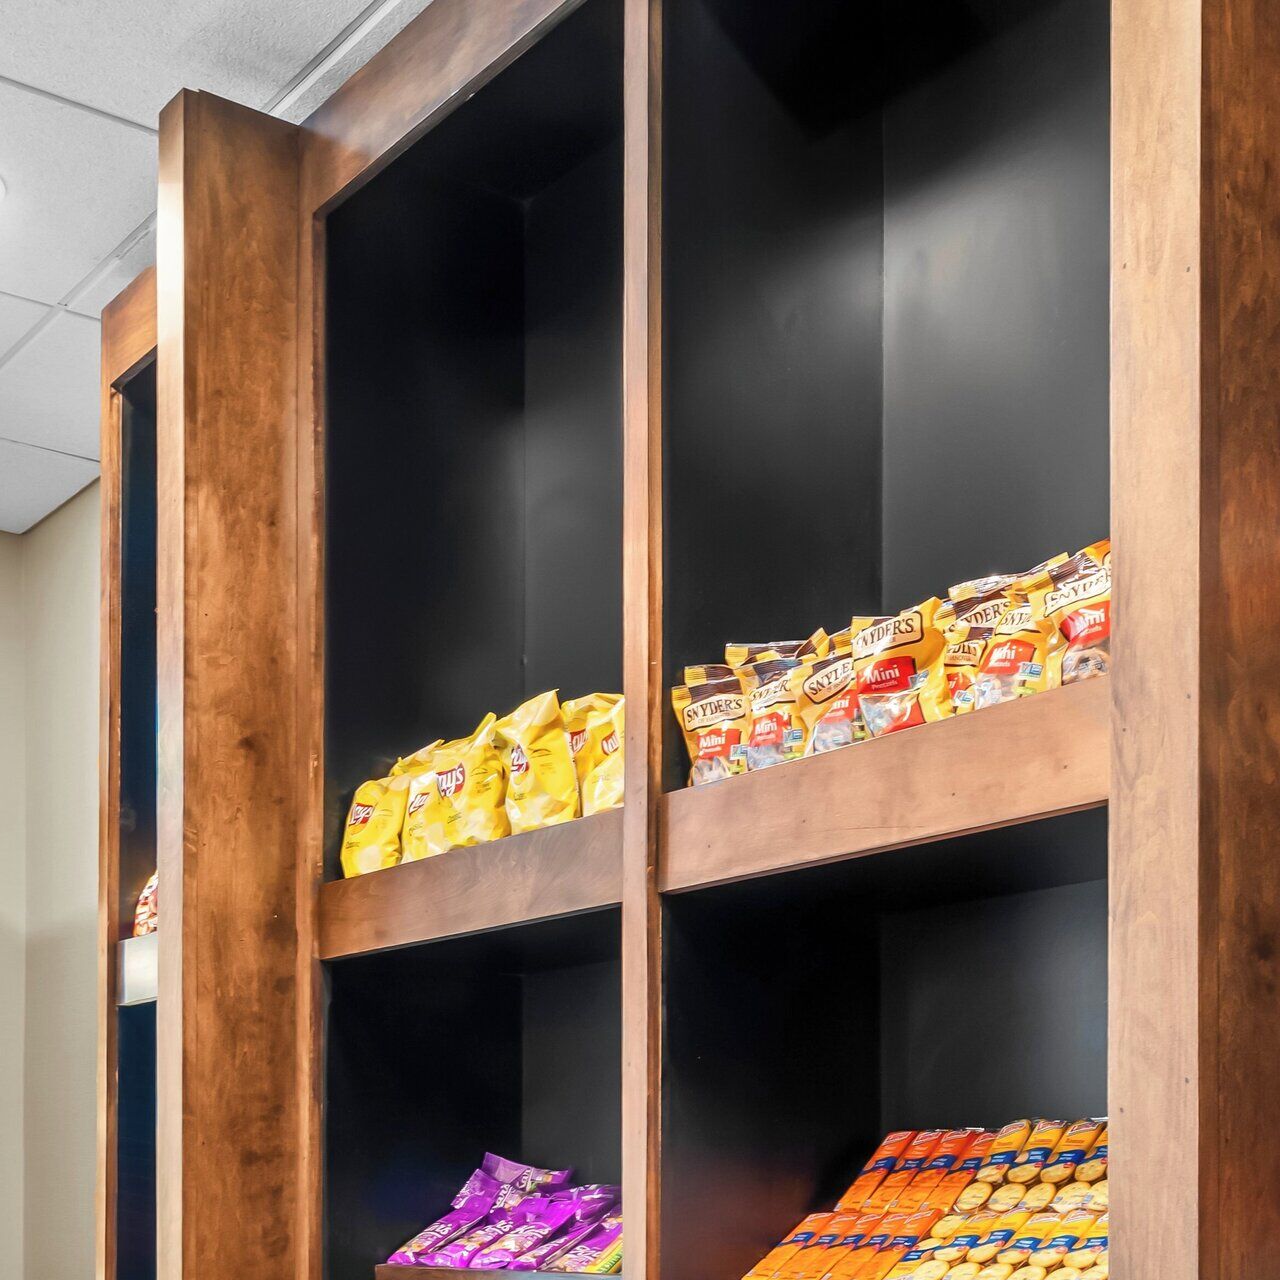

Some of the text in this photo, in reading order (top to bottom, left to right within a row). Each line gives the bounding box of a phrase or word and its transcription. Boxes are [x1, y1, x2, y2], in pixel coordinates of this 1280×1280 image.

[866, 663, 900, 685] Mini
[686, 698, 743, 723] SNYDER'S
[699, 732, 726, 748] Mini
